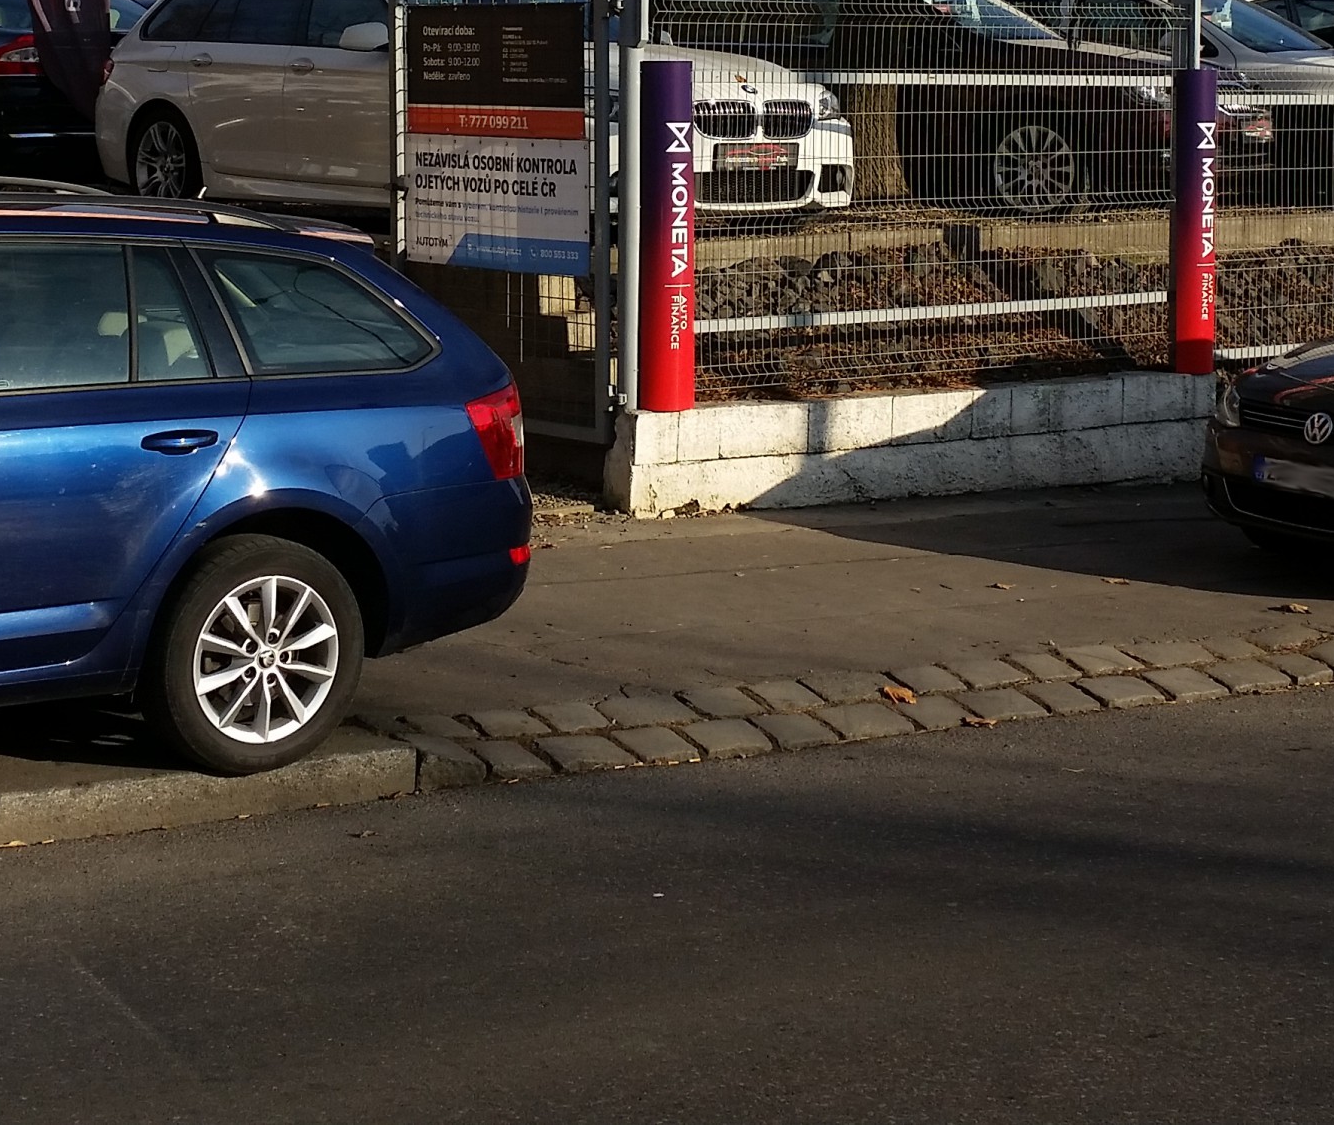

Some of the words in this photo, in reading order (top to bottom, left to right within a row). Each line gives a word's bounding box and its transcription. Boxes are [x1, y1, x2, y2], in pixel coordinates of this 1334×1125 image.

[422, 25, 454, 36] Otevírací
[454, 25, 476, 36] doba:
[422, 56, 445, 67] Sobota:
[447, 57, 481, 67] 9.00-12.00
[459, 114, 468, 128] T:
[469, 115, 488, 129] 777
[489, 116, 508, 129] 099
[510, 116, 528, 130] 211
[415, 148, 471, 170] NEZÁVISLÁ
[472, 153, 515, 173] OSOBNÍ
[516, 157, 578, 175] KONTROLA
[415, 171, 460, 192] OJETÝCH
[461, 173, 492, 194] VOZŮ
[493, 179, 510, 195] PO
[511, 177, 539, 197] CELÉ
[540, 177, 557, 198] ČR
[670, 162, 689, 278] MONETA
[1201, 157, 1215, 259] MONETA
[1201, 272, 1209, 321] FINANCE
[670, 294, 680, 351] FINANCE
